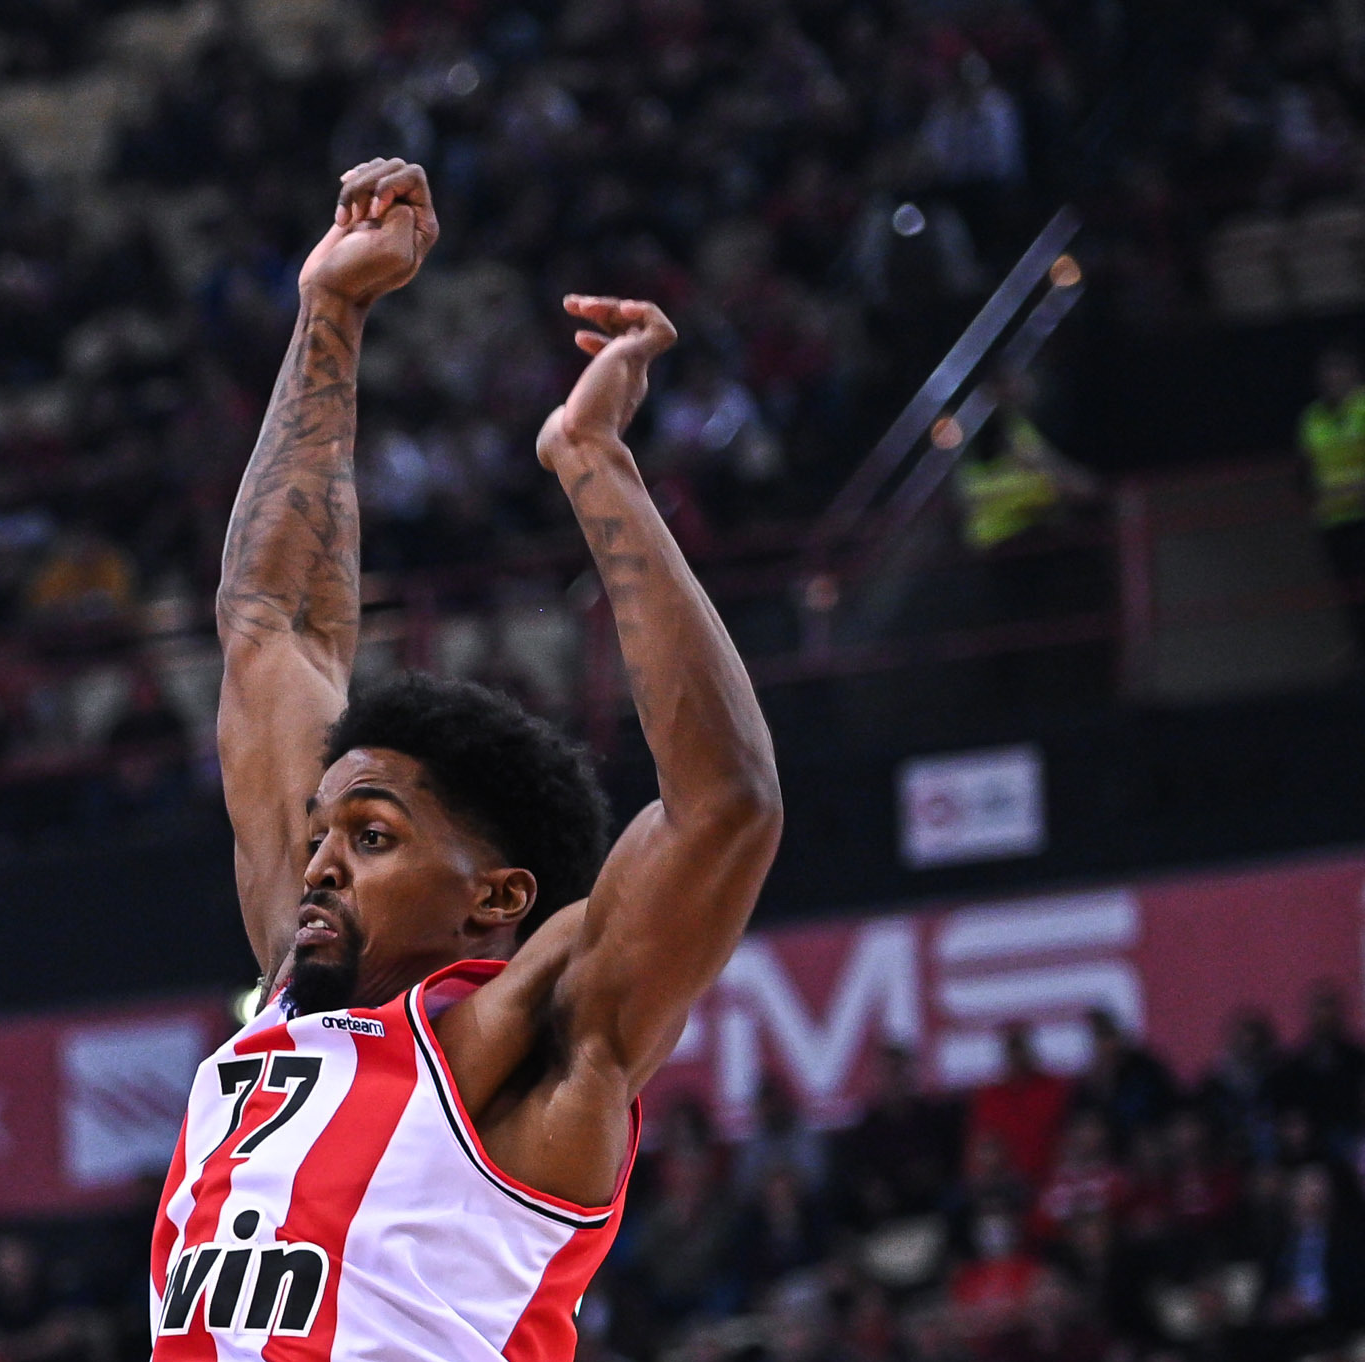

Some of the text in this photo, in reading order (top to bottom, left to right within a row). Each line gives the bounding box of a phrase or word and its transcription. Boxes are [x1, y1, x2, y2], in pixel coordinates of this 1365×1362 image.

[322, 1016, 384, 1035] oneteam
[199, 1056, 323, 1164] 77
[159, 1209, 329, 1336] win
